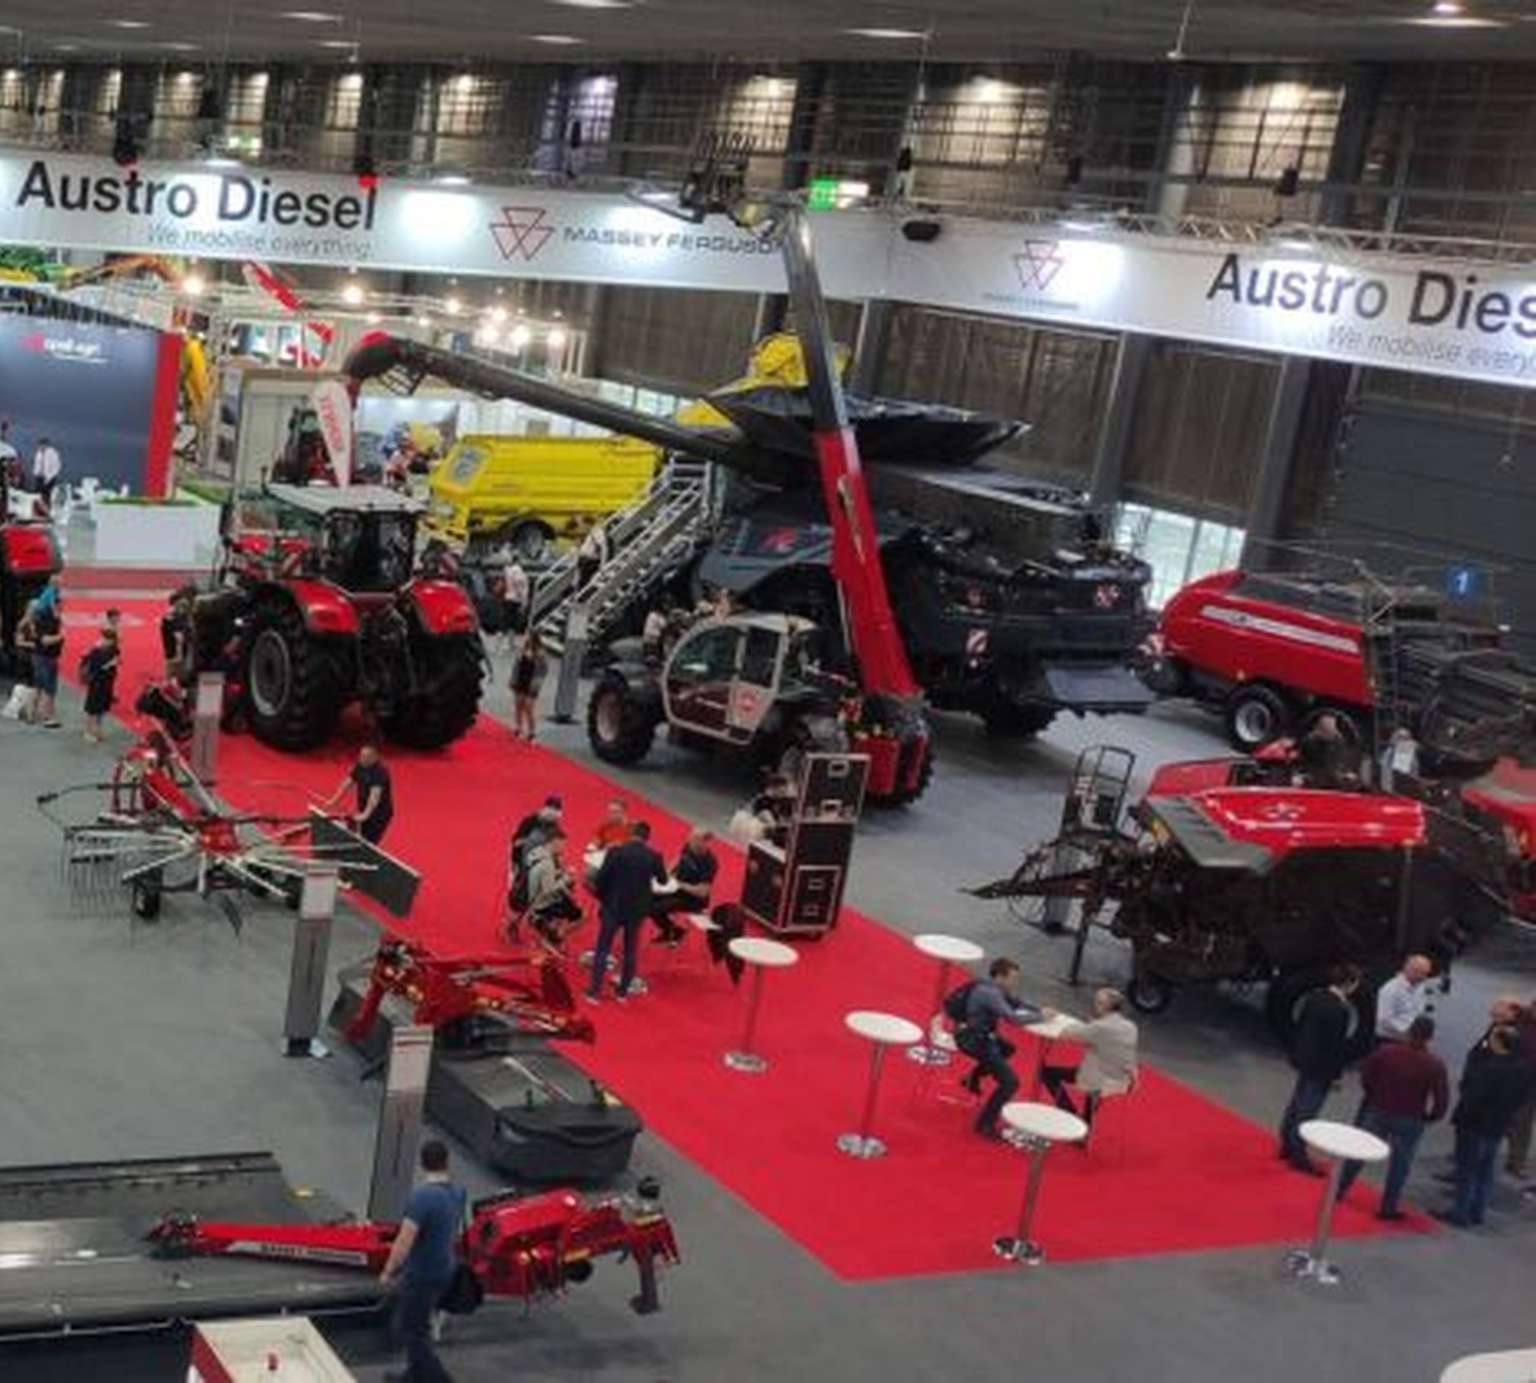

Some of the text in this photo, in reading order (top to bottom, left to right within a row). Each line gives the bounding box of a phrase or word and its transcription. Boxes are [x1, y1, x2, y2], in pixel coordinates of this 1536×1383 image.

[16, 160, 378, 230] Austro Diesel
[147, 222, 177, 244] We
[563, 226, 662, 248] MASSEY
[1206, 253, 1389, 319] Austro
[1455, 570, 1469, 595] 1
